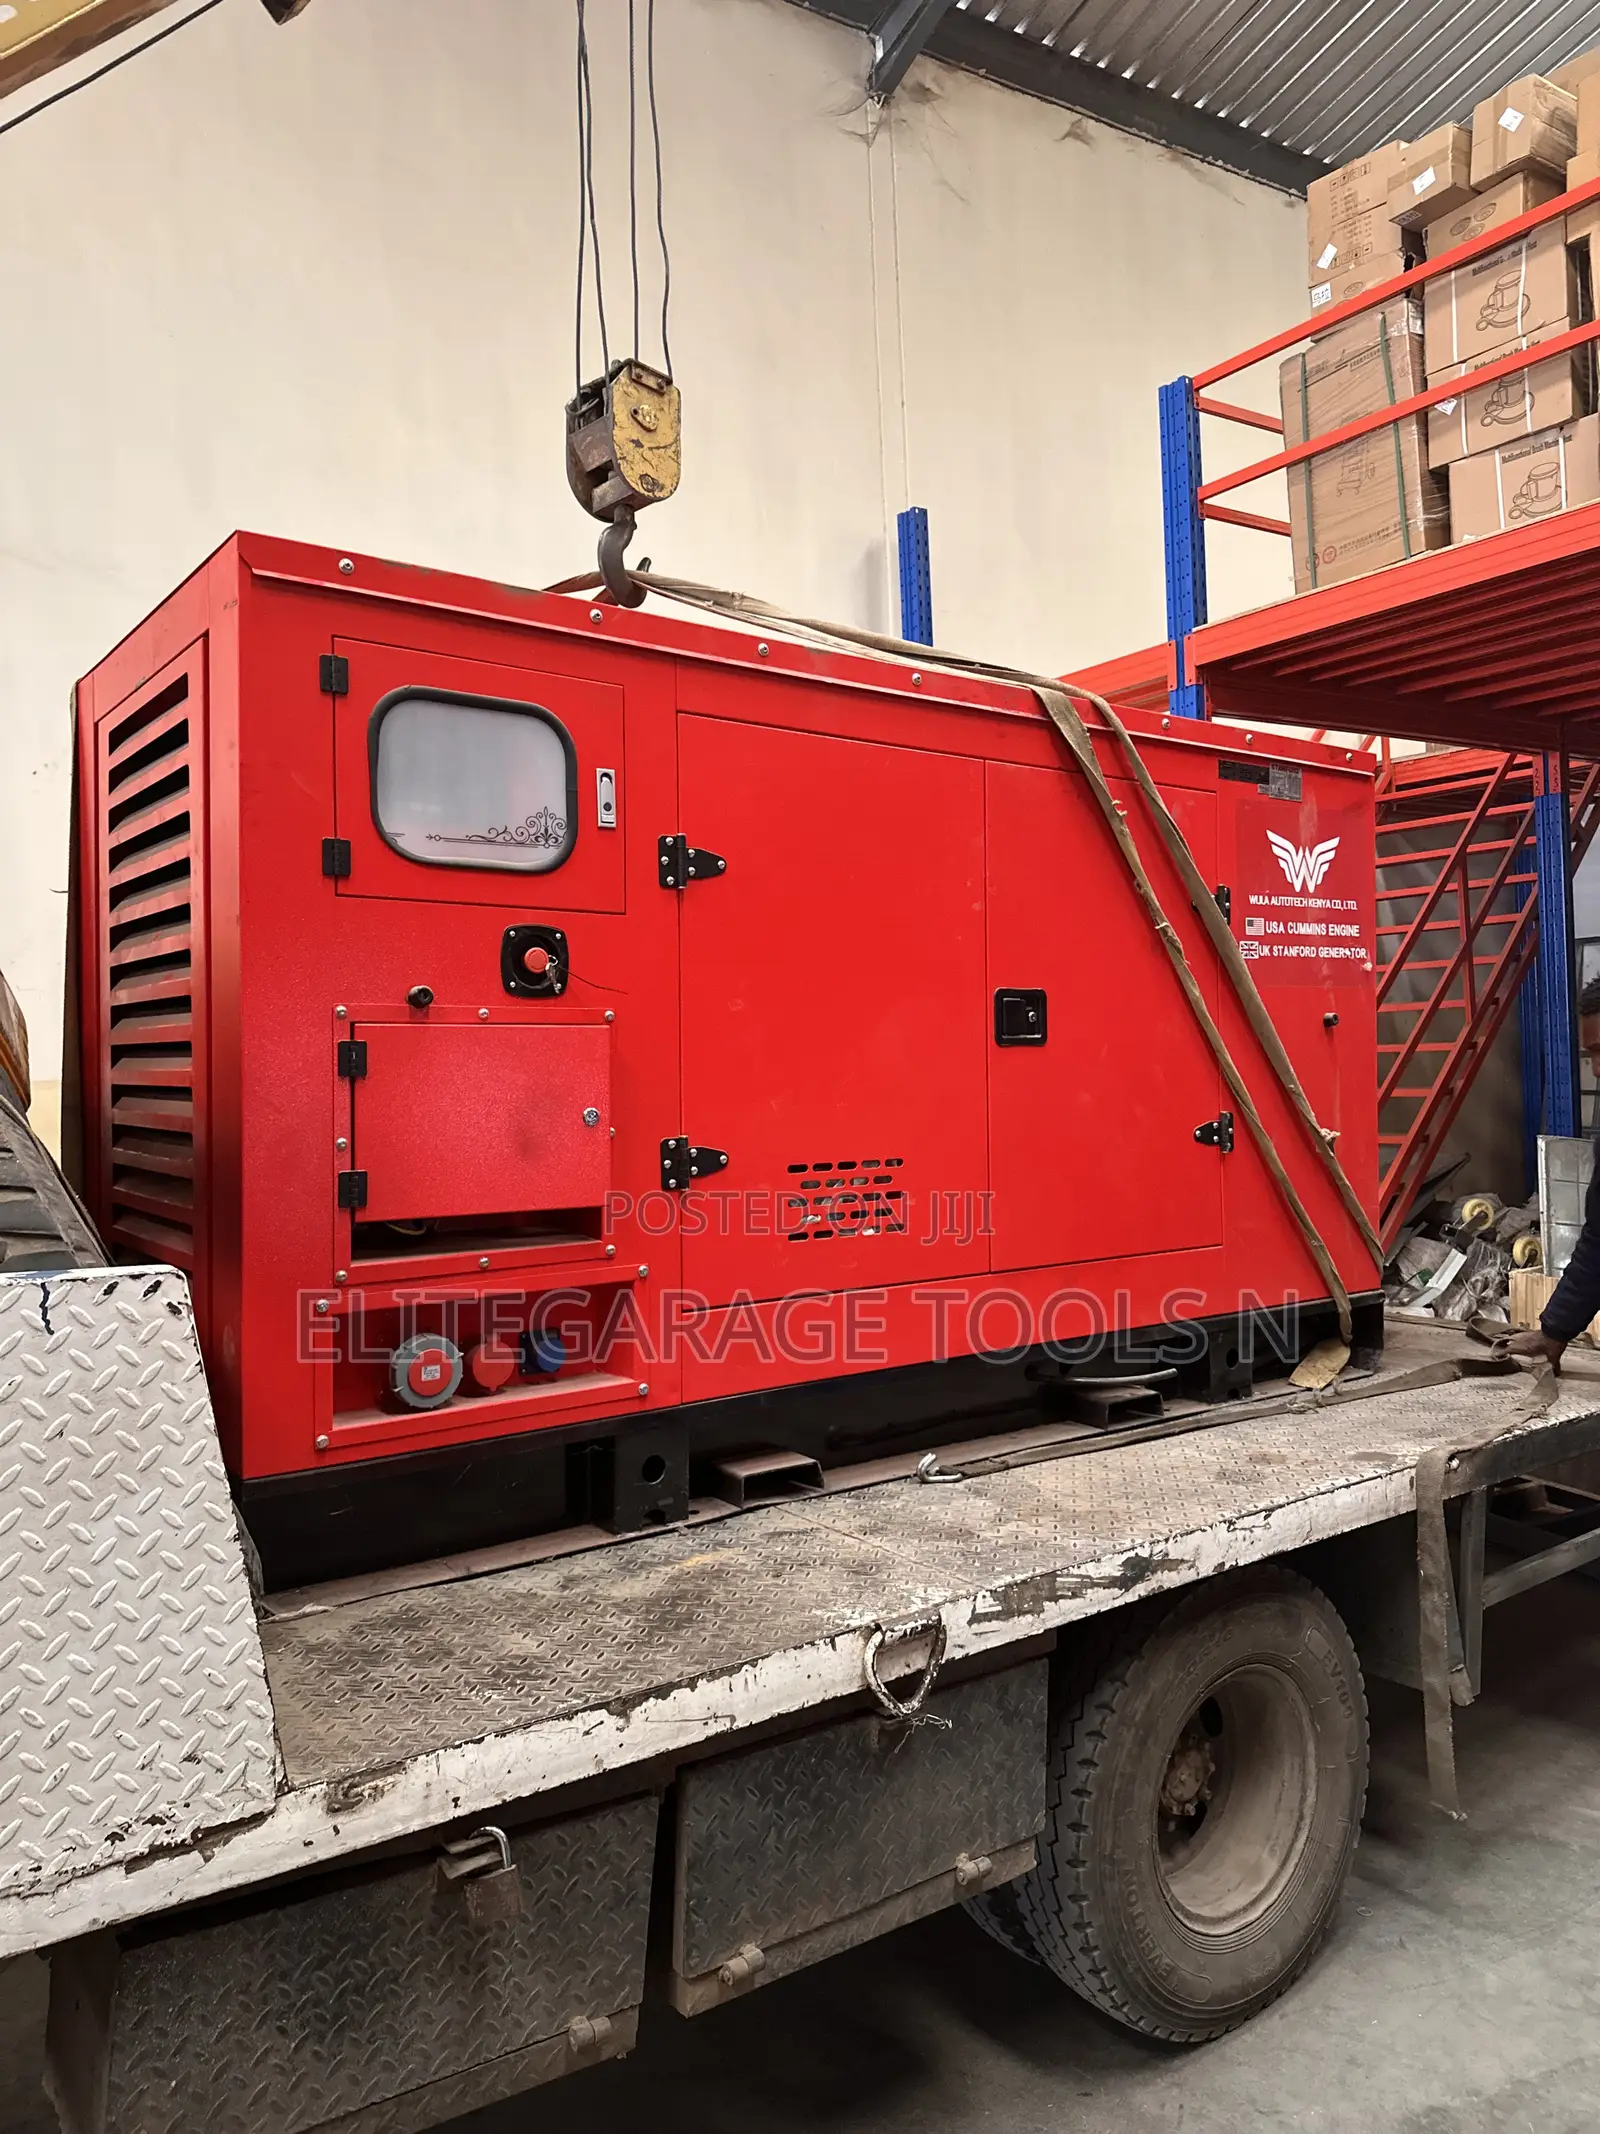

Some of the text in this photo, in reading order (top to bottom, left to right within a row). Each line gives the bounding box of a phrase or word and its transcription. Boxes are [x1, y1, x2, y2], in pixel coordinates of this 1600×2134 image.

[1249, 894, 1269, 905] WULA
[1271, 896, 1307, 907] AUTOTECH
[1308, 898, 1331, 909] KENYA
[1265, 920, 1360, 937] USA CUMMINS ENGINE
[1259, 944, 1271, 957] UK
[1273, 945, 1316, 957] STANFORD
